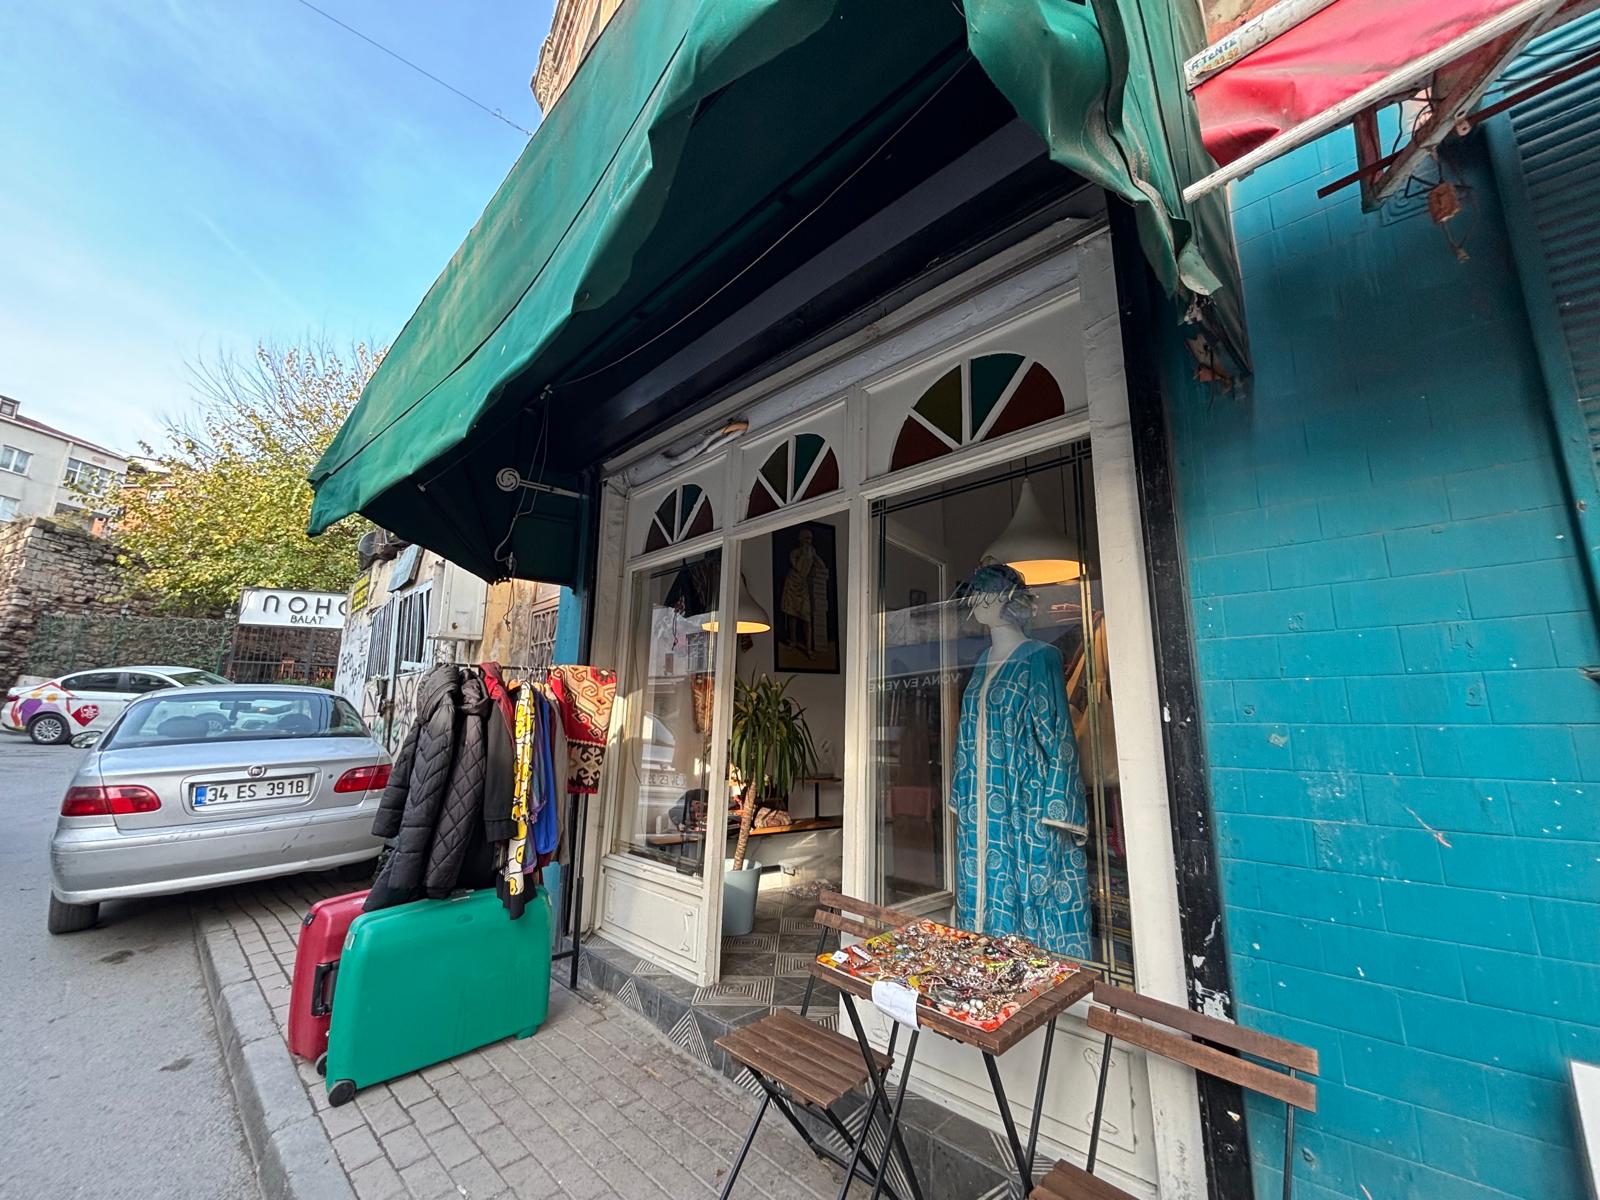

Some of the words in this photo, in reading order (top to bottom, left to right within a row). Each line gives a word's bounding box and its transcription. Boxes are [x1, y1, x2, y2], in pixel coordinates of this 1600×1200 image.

[290, 615, 324, 624] BALAT
[208, 787, 228, 802] 34
[237, 784, 257, 799] ES
[266, 780, 304, 796] 3918
